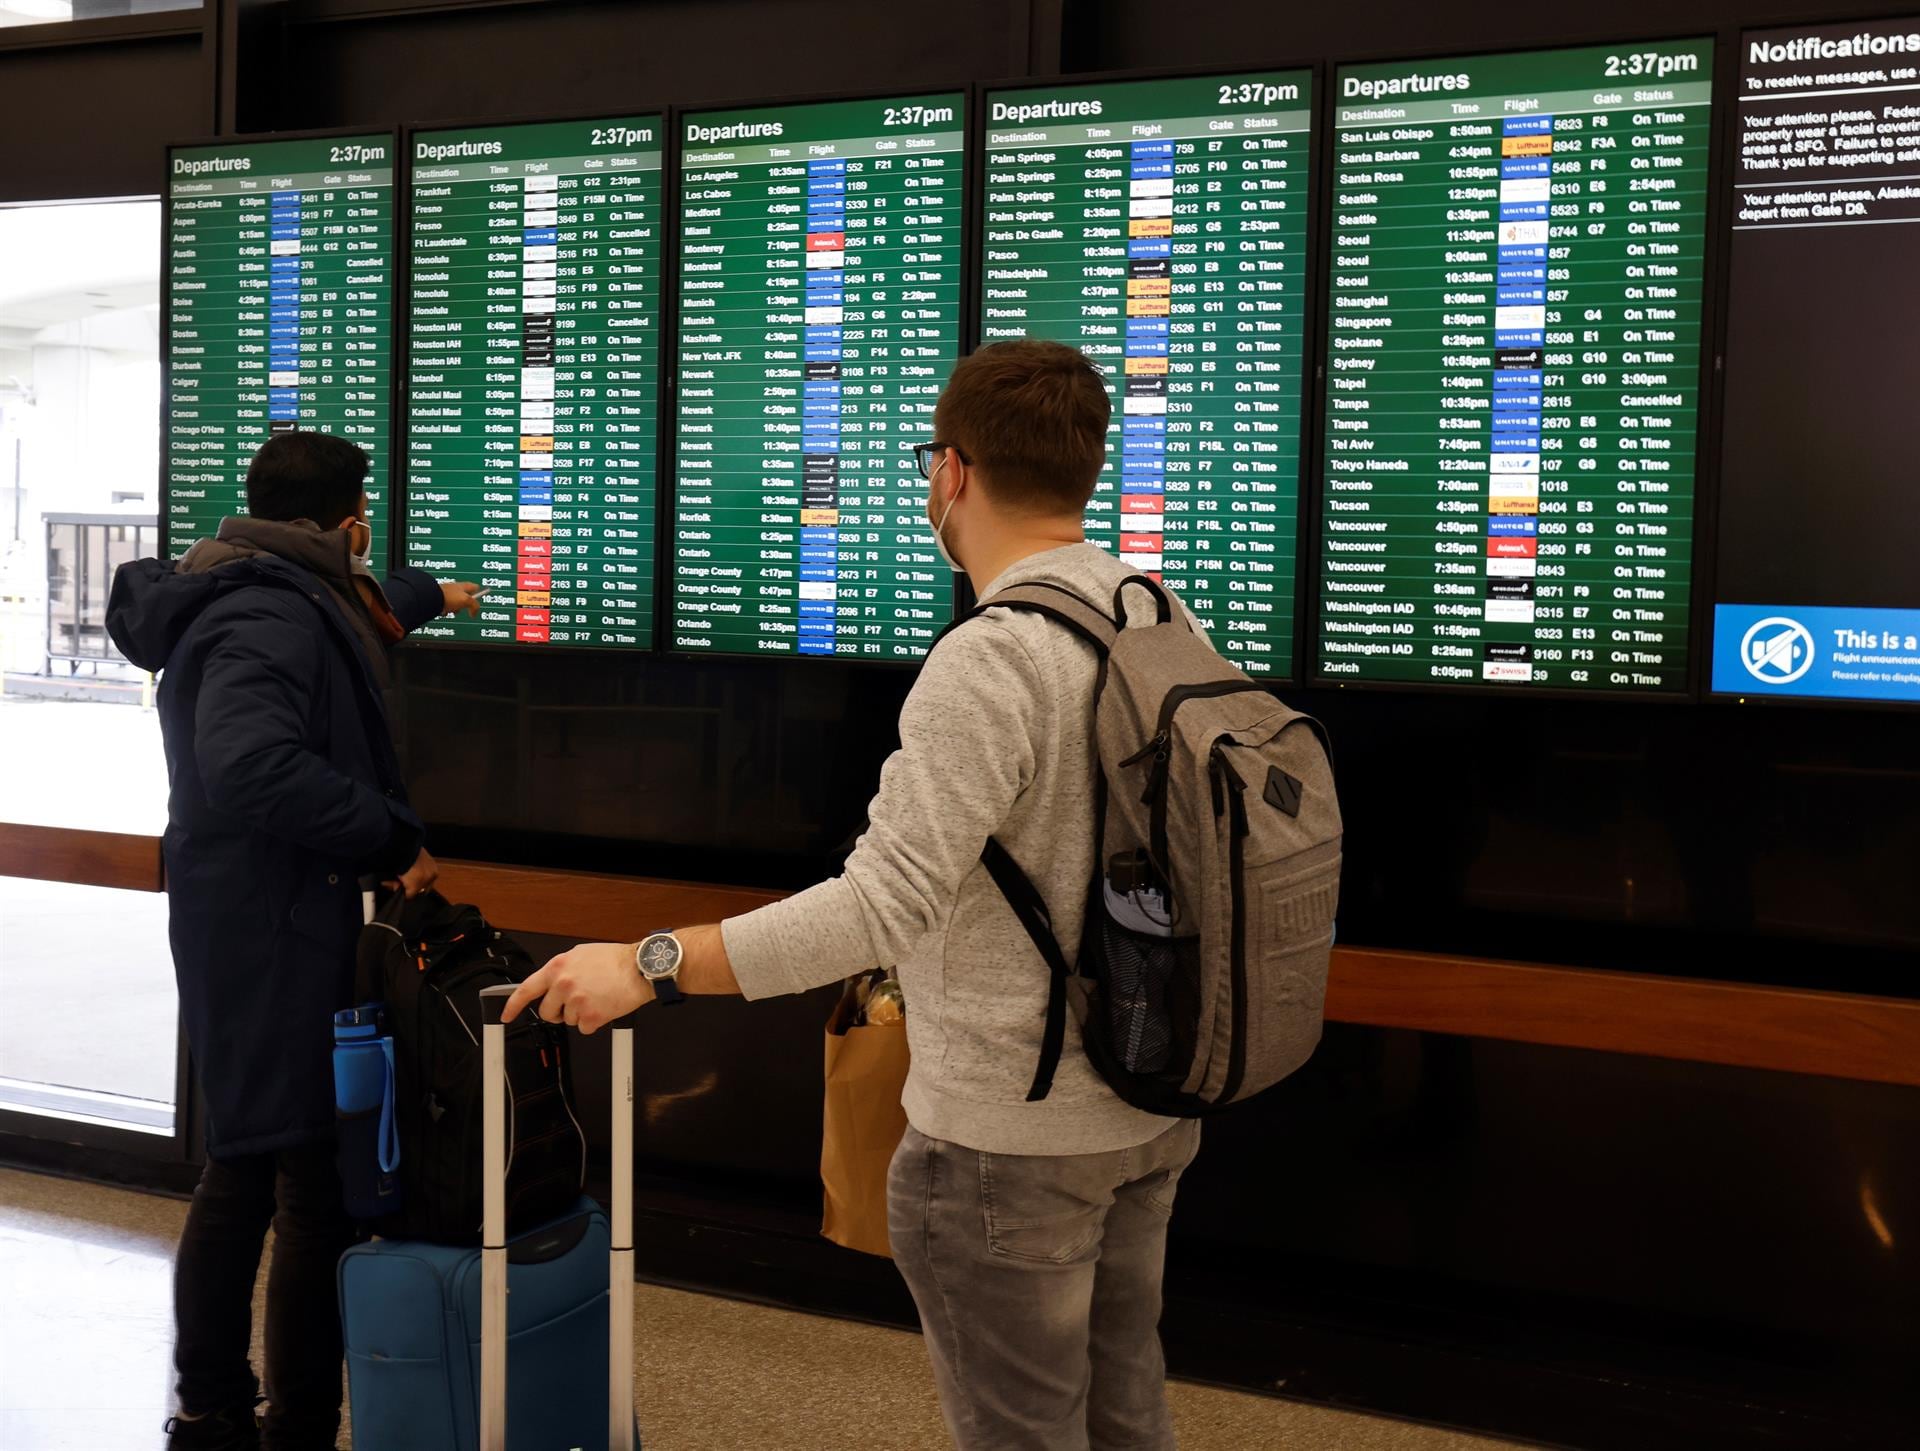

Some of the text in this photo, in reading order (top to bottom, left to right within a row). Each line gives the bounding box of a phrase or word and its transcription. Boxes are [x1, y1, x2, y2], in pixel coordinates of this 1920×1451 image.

[1750, 32, 1920, 63] Notifications
[1605, 53, 1697, 78] 2:37pm
[1746, 78, 1764, 89] To
[1765, 74, 1813, 88] receive
[1816, 70, 1888, 84] messages,
[1891, 68, 1916, 79] use
[1344, 74, 1470, 100] Departures
[1219, 83, 1298, 106] 2:37pm
[1593, 93, 1623, 105] Gate
[1633, 90, 1674, 102] Status
[993, 100, 1103, 123] Departures
[1451, 104, 1480, 114] Time
[1504, 99, 1539, 113] Flight
[884, 106, 953, 127] 2:37pm
[1342, 108, 1406, 121] Destination
[1632, 112, 1685, 125] On Time
[1744, 116, 1772, 128] Your
[1774, 112, 1828, 126] attention
[1209, 120, 1234, 131] Gate
[1244, 118, 1278, 129] Status
[687, 122, 783, 144] Departures
[1086, 128, 1111, 138] Time
[1132, 124, 1162, 137] Flight
[1341, 129, 1434, 143] San Luis Obispo
[1743, 128, 1793, 144] properly
[1795, 128, 1826, 139] wear
[1829, 126, 1838, 136] a
[1840, 122, 1874, 136] facial
[591, 128, 652, 147] 2:37pm
[905, 139, 936, 148] Status
[991, 132, 1047, 143] Destination
[1591, 137, 1617, 149] F3A
[1631, 134, 1684, 147] On Time
[809, 145, 835, 156] Flight
[875, 141, 898, 150] Gate
[1176, 144, 1195, 154] 759
[1208, 141, 1223, 152] E7
[1243, 139, 1288, 150] On Time
[1553, 140, 1582, 152] 8942
[1742, 144, 1777, 156] areas
[1780, 142, 1792, 154] at
[1794, 140, 1828, 152] SFO.
[1834, 136, 1878, 150] Failure
[1880, 136, 1894, 148] to
[330, 146, 385, 164] 2:37pm
[417, 141, 502, 161] Departures
[769, 148, 791, 157] Time
[1085, 148, 1123, 160] 4:05pm
[1340, 150, 1420, 164] Santa Barbara
[1449, 146, 1492, 159] 4:34pm
[611, 158, 638, 167] Status
[686, 152, 735, 163] Destination
[905, 158, 945, 168] On Time
[991, 152, 1056, 164] Palm Springs
[1742, 156, 1781, 170] Thank
[1782, 157, 1806, 170] you
[1808, 154, 1826, 166] for
[1828, 150, 1894, 166] supporting
[174, 157, 251, 176] Departures
[489, 166, 509, 174] Time
[525, 163, 549, 173] Flight
[584, 160, 604, 168] Gate
[846, 163, 864, 173] 552
[875, 160, 892, 170] F21
[324, 176, 342, 184] Gate
[347, 174, 372, 183] Status
[416, 169, 460, 179] Destination
[686, 171, 739, 182] Los Angeles
[271, 178, 293, 189] Flight
[584, 177, 601, 187] G12
[610, 176, 641, 187] 2:31pm
[174, 184, 213, 193] Destination
[416, 187, 451, 197] Frankfurt
[1744, 194, 1772, 206] Your
[1774, 190, 1827, 206] attention
[173, 200, 222, 210] Arcata-Eureka
[1738, 204, 1778, 221] depart
[1780, 206, 1808, 218] from
[1811, 204, 1842, 216] Gate
[173, 218, 196, 227] Aspen
[609, 228, 651, 239] Cancelled
[989, 229, 1064, 241] Paris De Gaulle
[1083, 227, 1121, 239] 2:20pm
[988, 268, 1048, 280] Philadelphia
[1443, 314, 1486, 327] 8:50pm
[1546, 311, 1562, 323] 33
[1584, 309, 1602, 321] G4
[1335, 317, 1392, 330] Singapore
[172, 378, 199, 388] Calgary
[1332, 399, 1370, 411] Tampa
[1441, 397, 1489, 410] 10:35pm
[1621, 394, 1682, 406] Cancelled
[1331, 460, 1409, 472] Tokyo Haneda
[1438, 460, 1487, 471] 12:20am
[1541, 460, 1563, 471] 107
[410, 492, 450, 503] Las Vegas
[678, 566, 742, 578] Orange County
[760, 568, 793, 579] 4:17pm
[866, 570, 877, 579] F1
[1834, 629, 1917, 650] This is a
[1833, 652, 1860, 664] Flight
[1324, 662, 1360, 673] Zurich
[1431, 666, 1473, 679] 8:05pm
[1533, 670, 1548, 681] 39
[1571, 670, 1589, 682] G2
[1832, 670, 1860, 680] Please
[1860, 672, 1880, 680] refer
[1882, 674, 1891, 682] to
